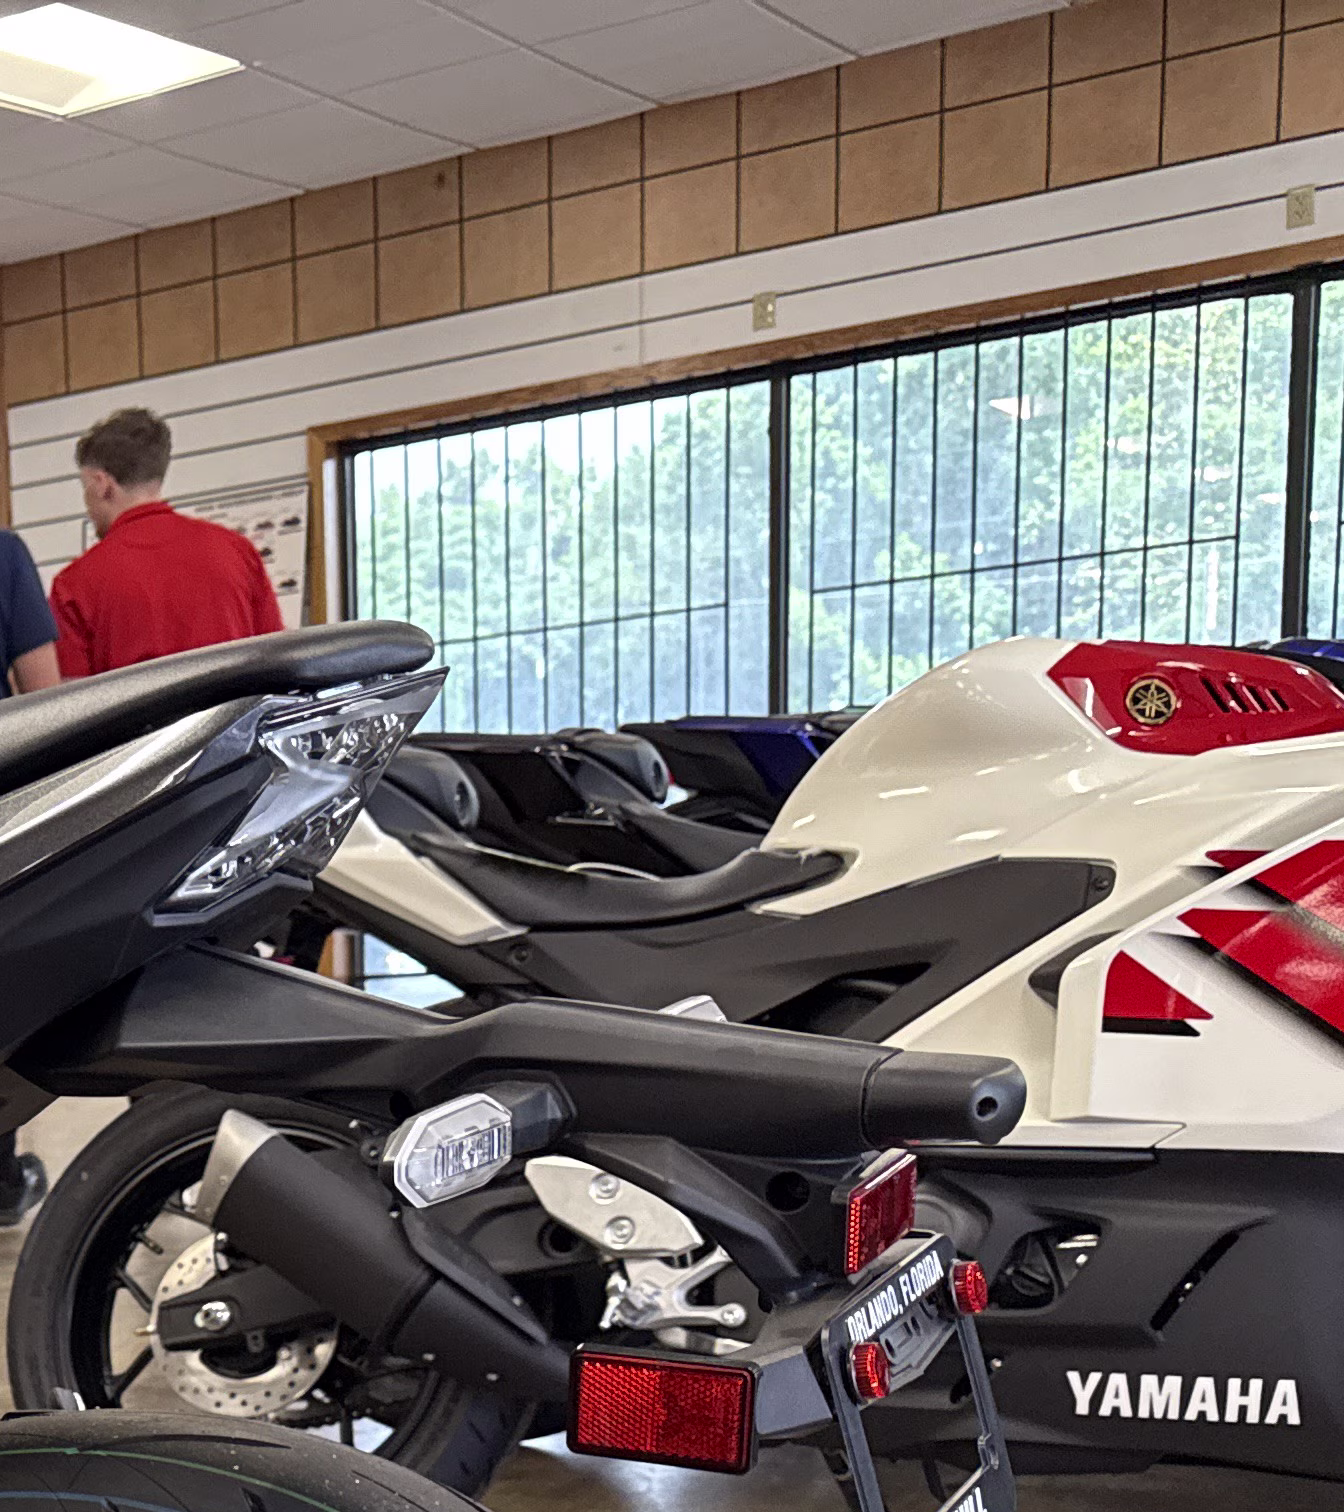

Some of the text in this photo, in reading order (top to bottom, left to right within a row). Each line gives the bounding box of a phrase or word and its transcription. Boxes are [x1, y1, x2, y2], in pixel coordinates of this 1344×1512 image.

[846, 1250, 944, 1343] ORLANDO, FLORIDA
[1065, 1370, 1302, 1426] YAMAHA
